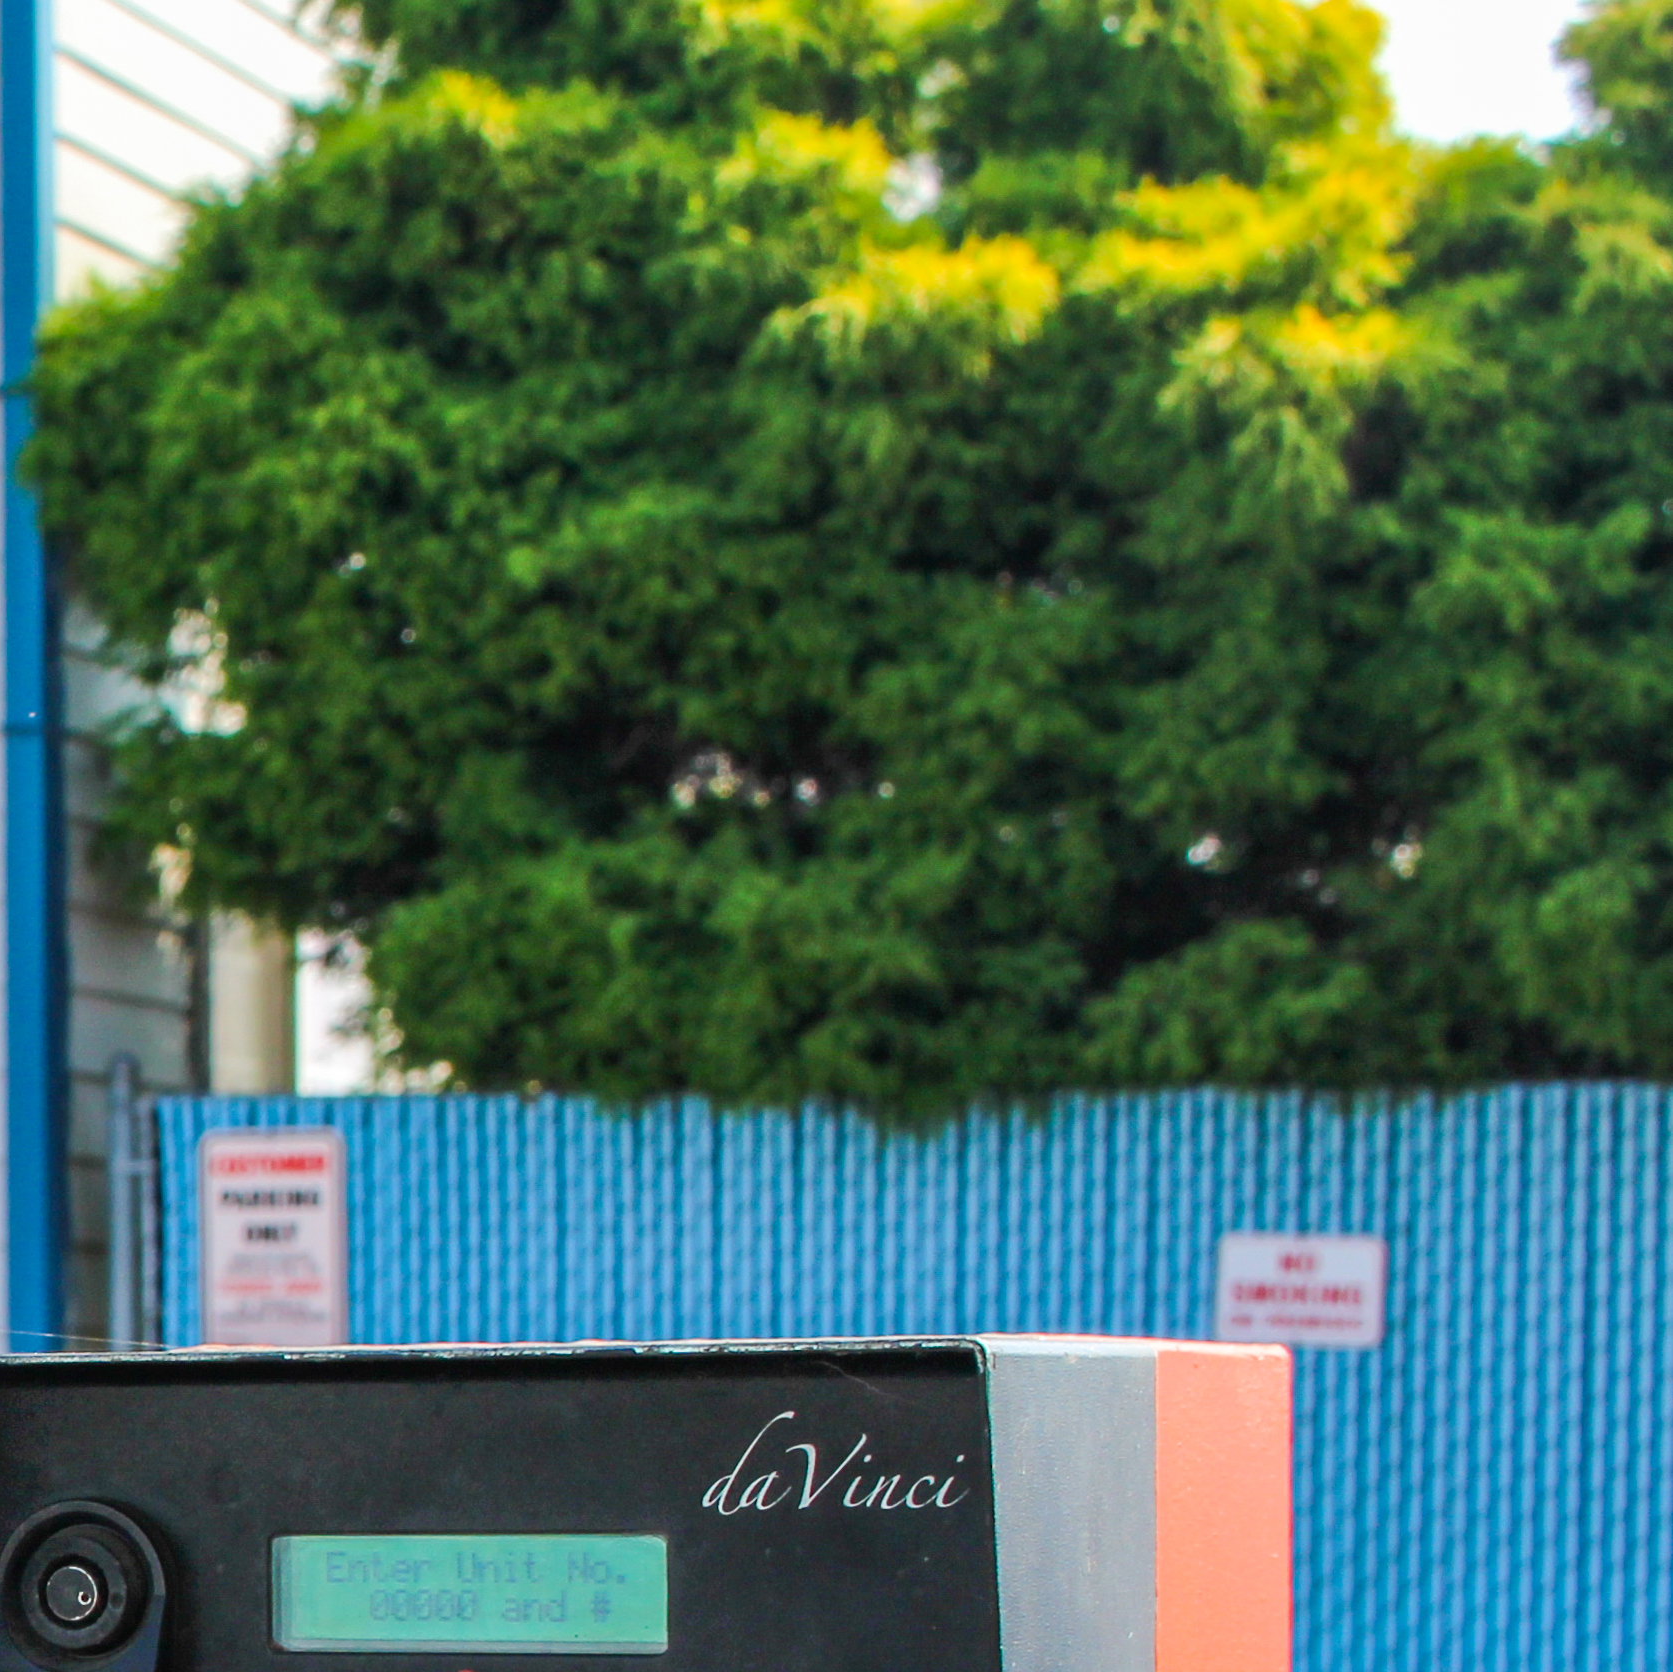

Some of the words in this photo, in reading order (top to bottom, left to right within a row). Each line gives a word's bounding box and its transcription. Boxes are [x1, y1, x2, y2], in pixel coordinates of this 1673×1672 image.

[702, 1411, 970, 1515] daVinci
[325, 1550, 432, 1584] Enter
[456, 1550, 543, 1584] Unit
[566, 1551, 628, 1585] No.
[369, 1588, 478, 1623] 00000
[501, 1590, 568, 1624] and
